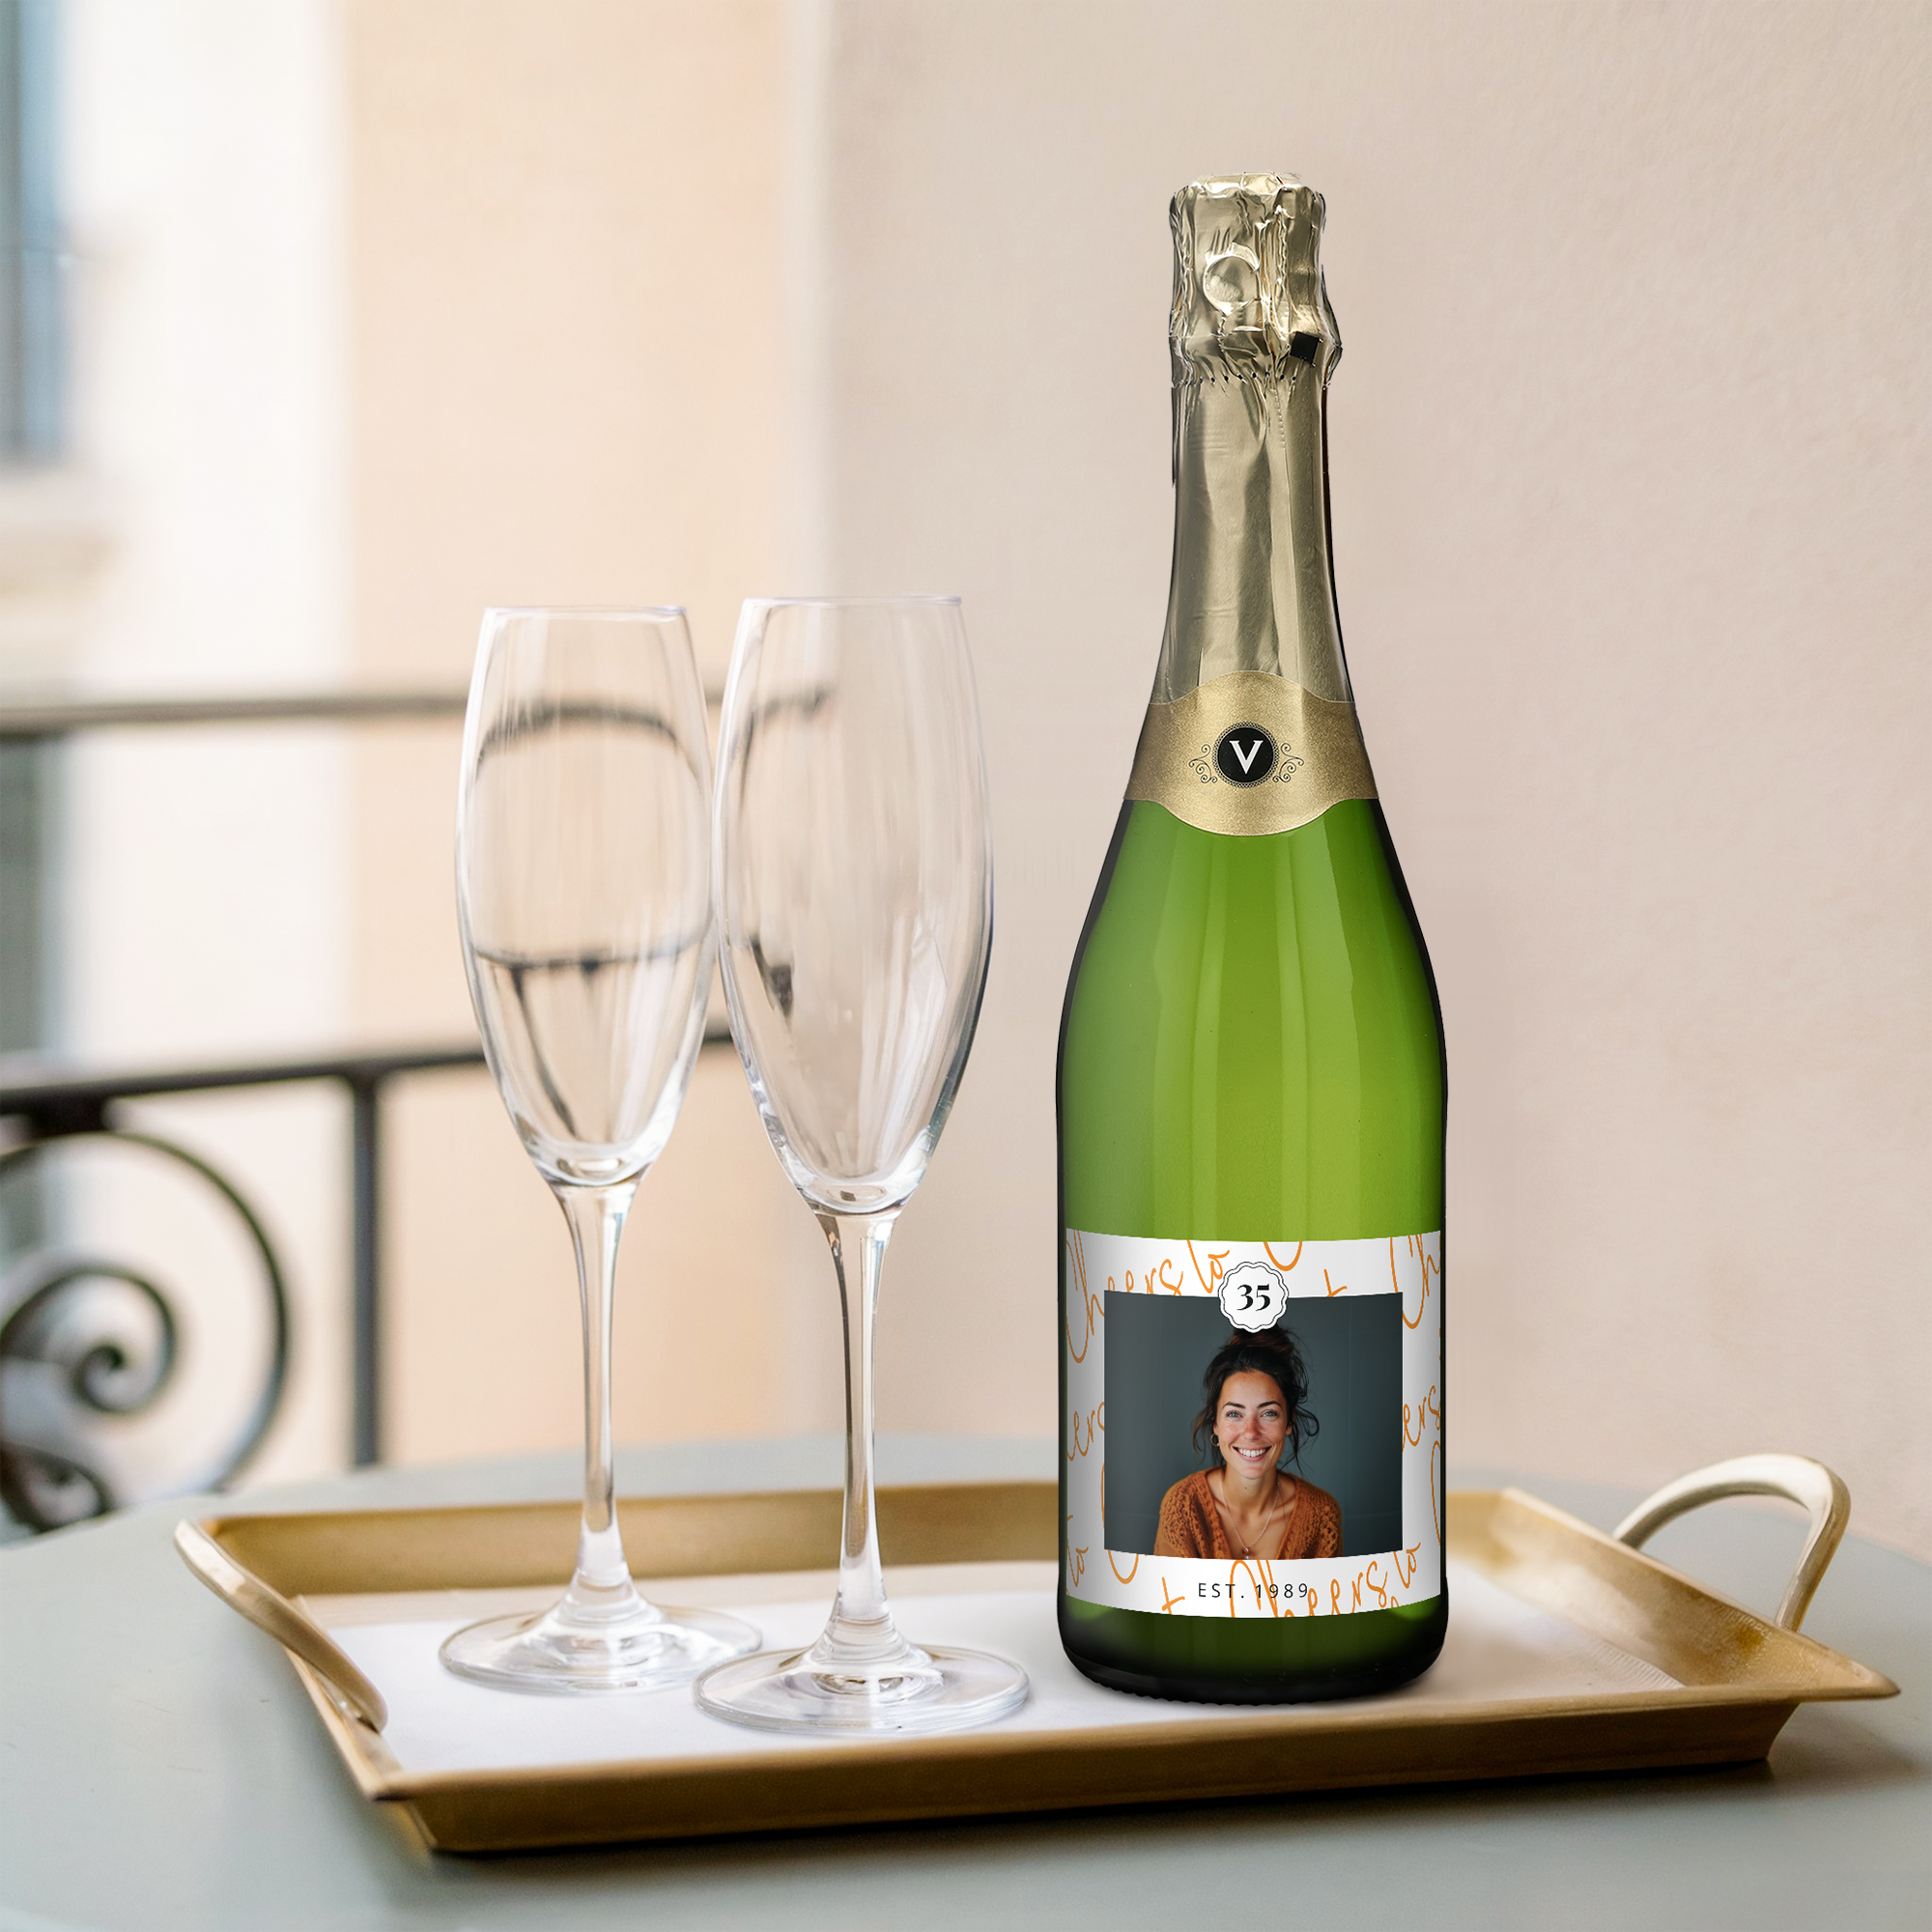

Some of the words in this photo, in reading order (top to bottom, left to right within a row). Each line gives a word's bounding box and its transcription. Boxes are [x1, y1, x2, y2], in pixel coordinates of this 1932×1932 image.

[1229, 740, 1264, 775] V
[1236, 1284, 1271, 1312] 35
[1198, 1582, 1244, 1599] EST.
[1256, 1582, 1308, 1599] 1989
